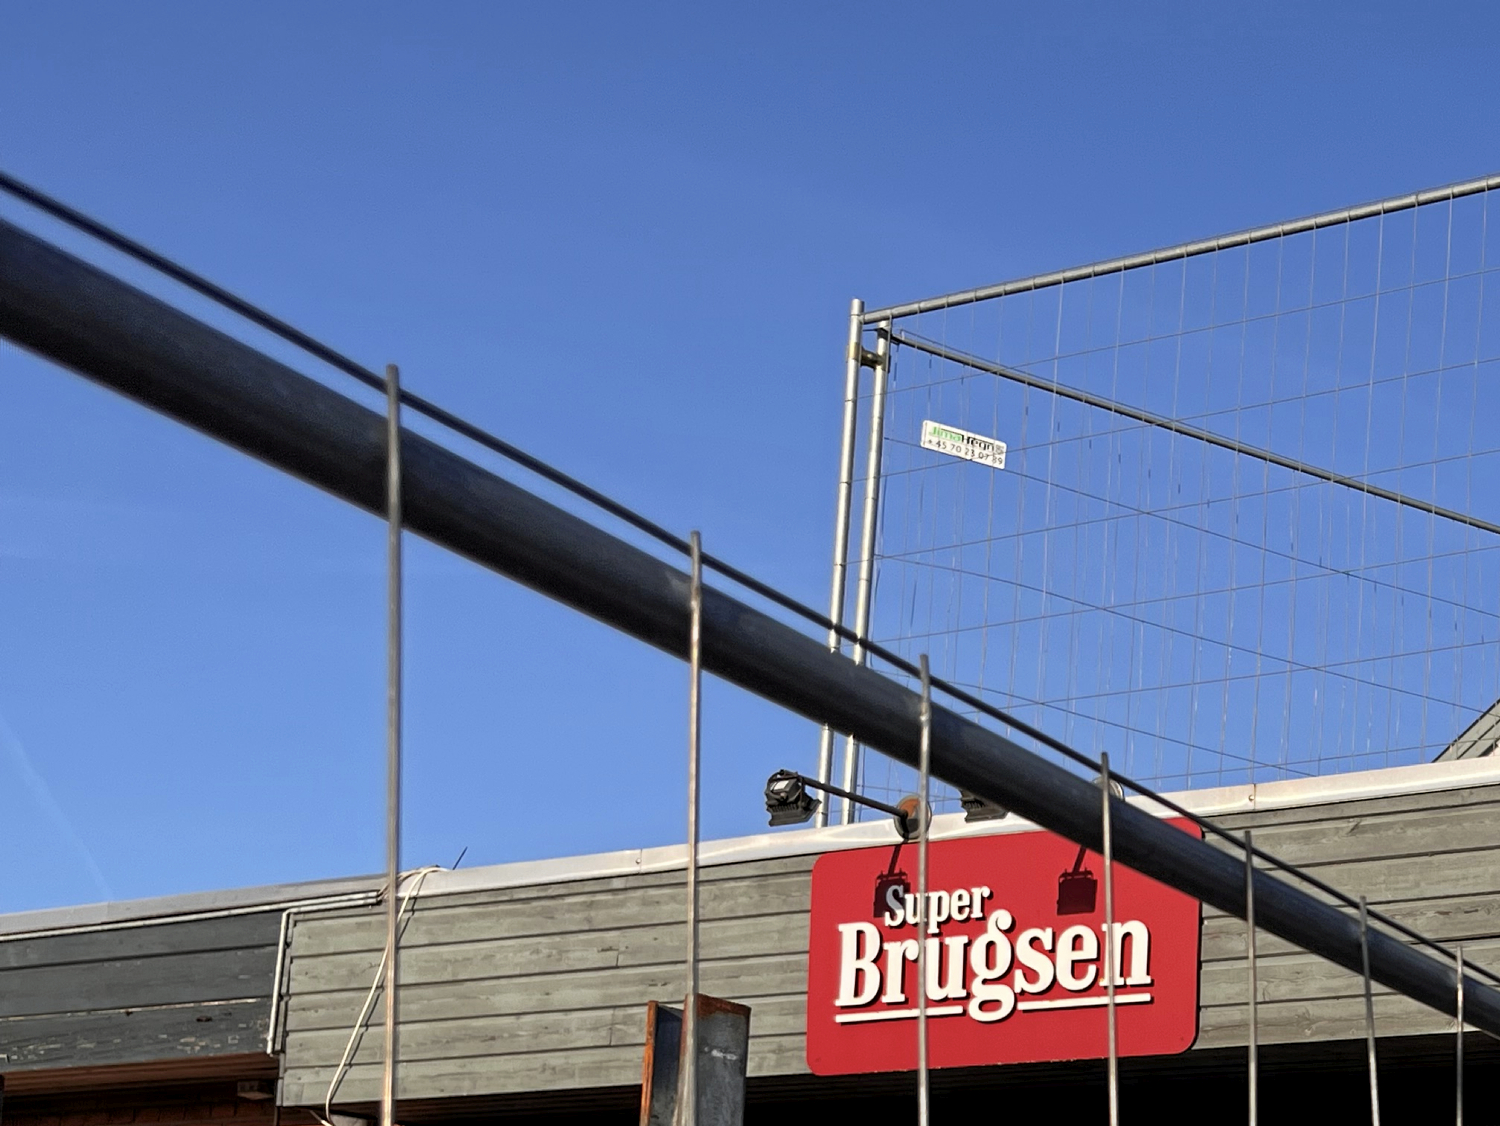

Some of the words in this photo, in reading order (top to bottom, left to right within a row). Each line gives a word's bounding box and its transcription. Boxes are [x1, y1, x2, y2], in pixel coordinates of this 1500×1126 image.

[936, 440, 947, 449] 45
[950, 444, 962, 453] 70
[965, 448, 975, 458] 23
[884, 885, 990, 934] Super
[834, 908, 1153, 1023] Brugsen
